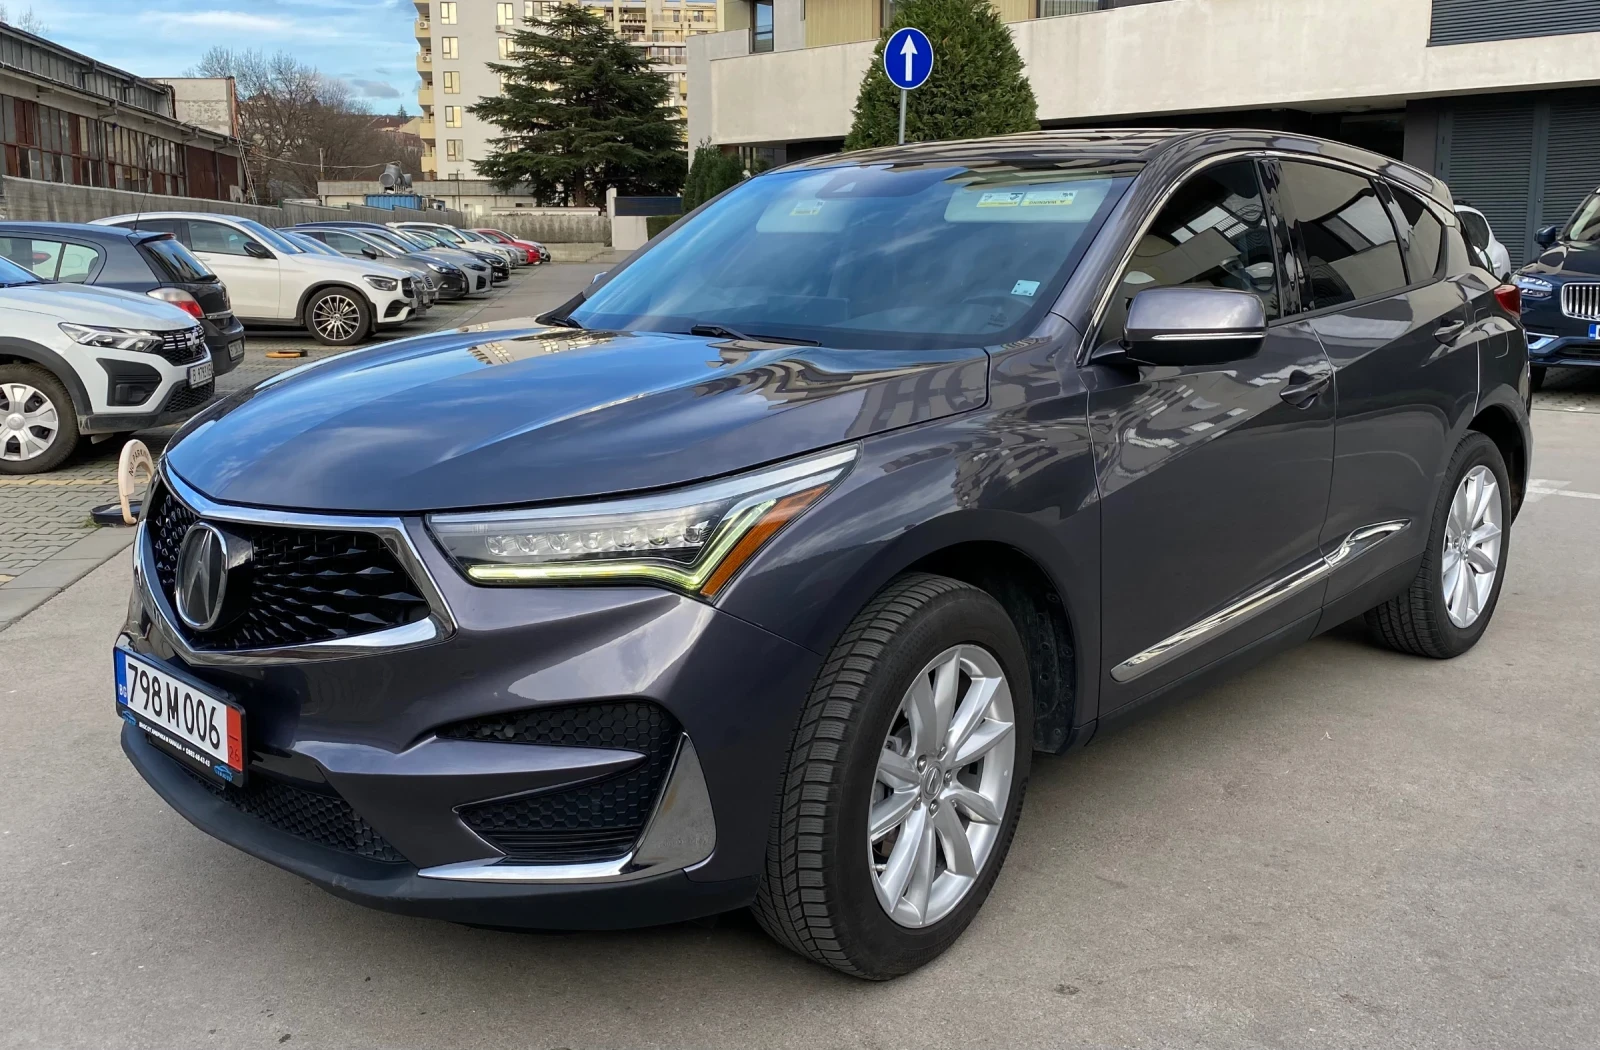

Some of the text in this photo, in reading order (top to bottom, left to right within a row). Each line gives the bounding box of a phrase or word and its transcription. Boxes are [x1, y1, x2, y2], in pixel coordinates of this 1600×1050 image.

[129, 462, 135, 476] NO
[119, 683, 128, 698] BG
[229, 745, 240, 762] 26
